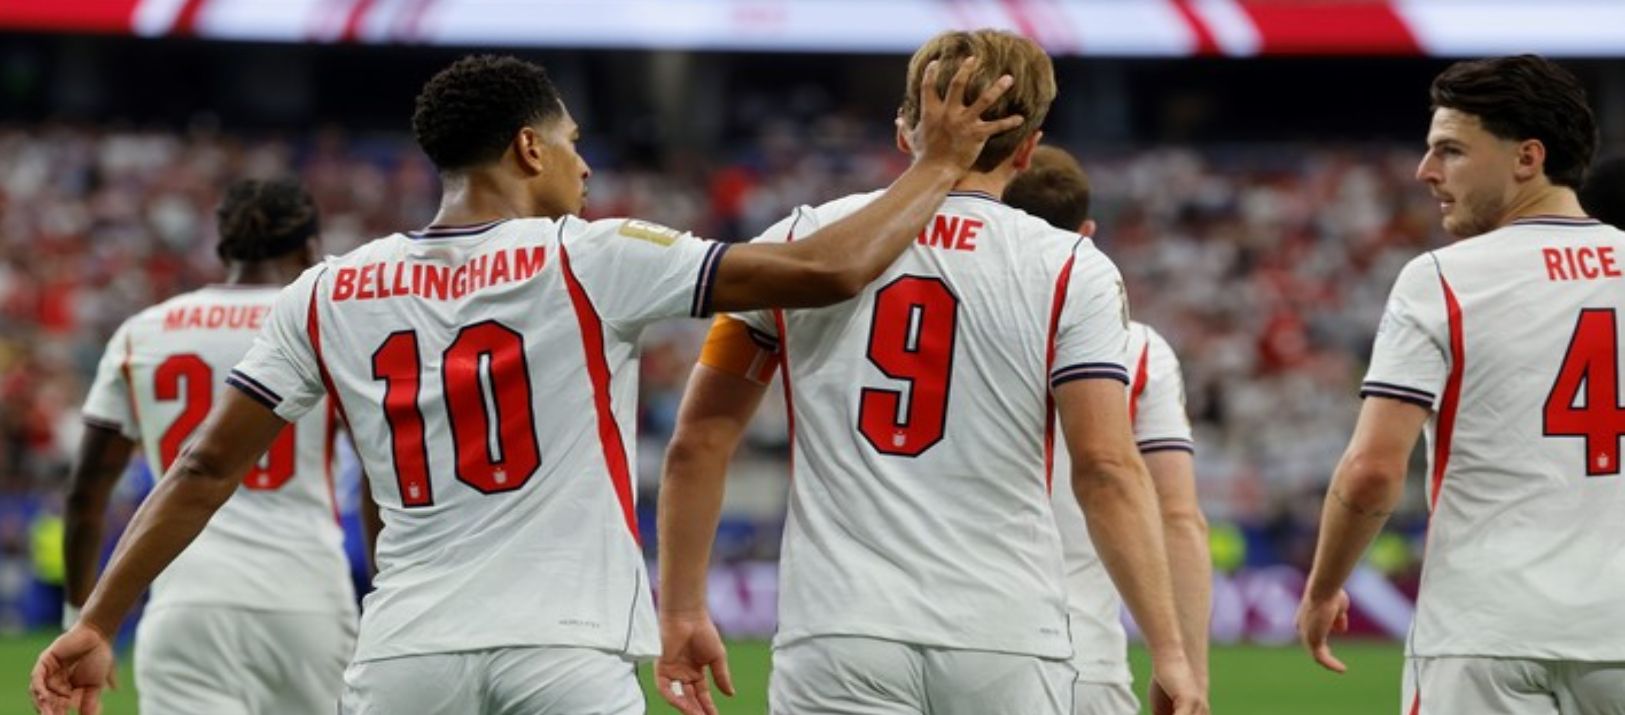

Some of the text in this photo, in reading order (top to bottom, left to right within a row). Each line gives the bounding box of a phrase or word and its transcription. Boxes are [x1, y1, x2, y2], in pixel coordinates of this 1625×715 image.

[163, 304, 270, 332] MADUE
[332, 246, 546, 302] BELLINGHAM
[1542, 246, 1621, 281] RICE
[371, 319, 542, 508] 10
[857, 273, 959, 458] 9
[1542, 307, 1625, 477] 4
